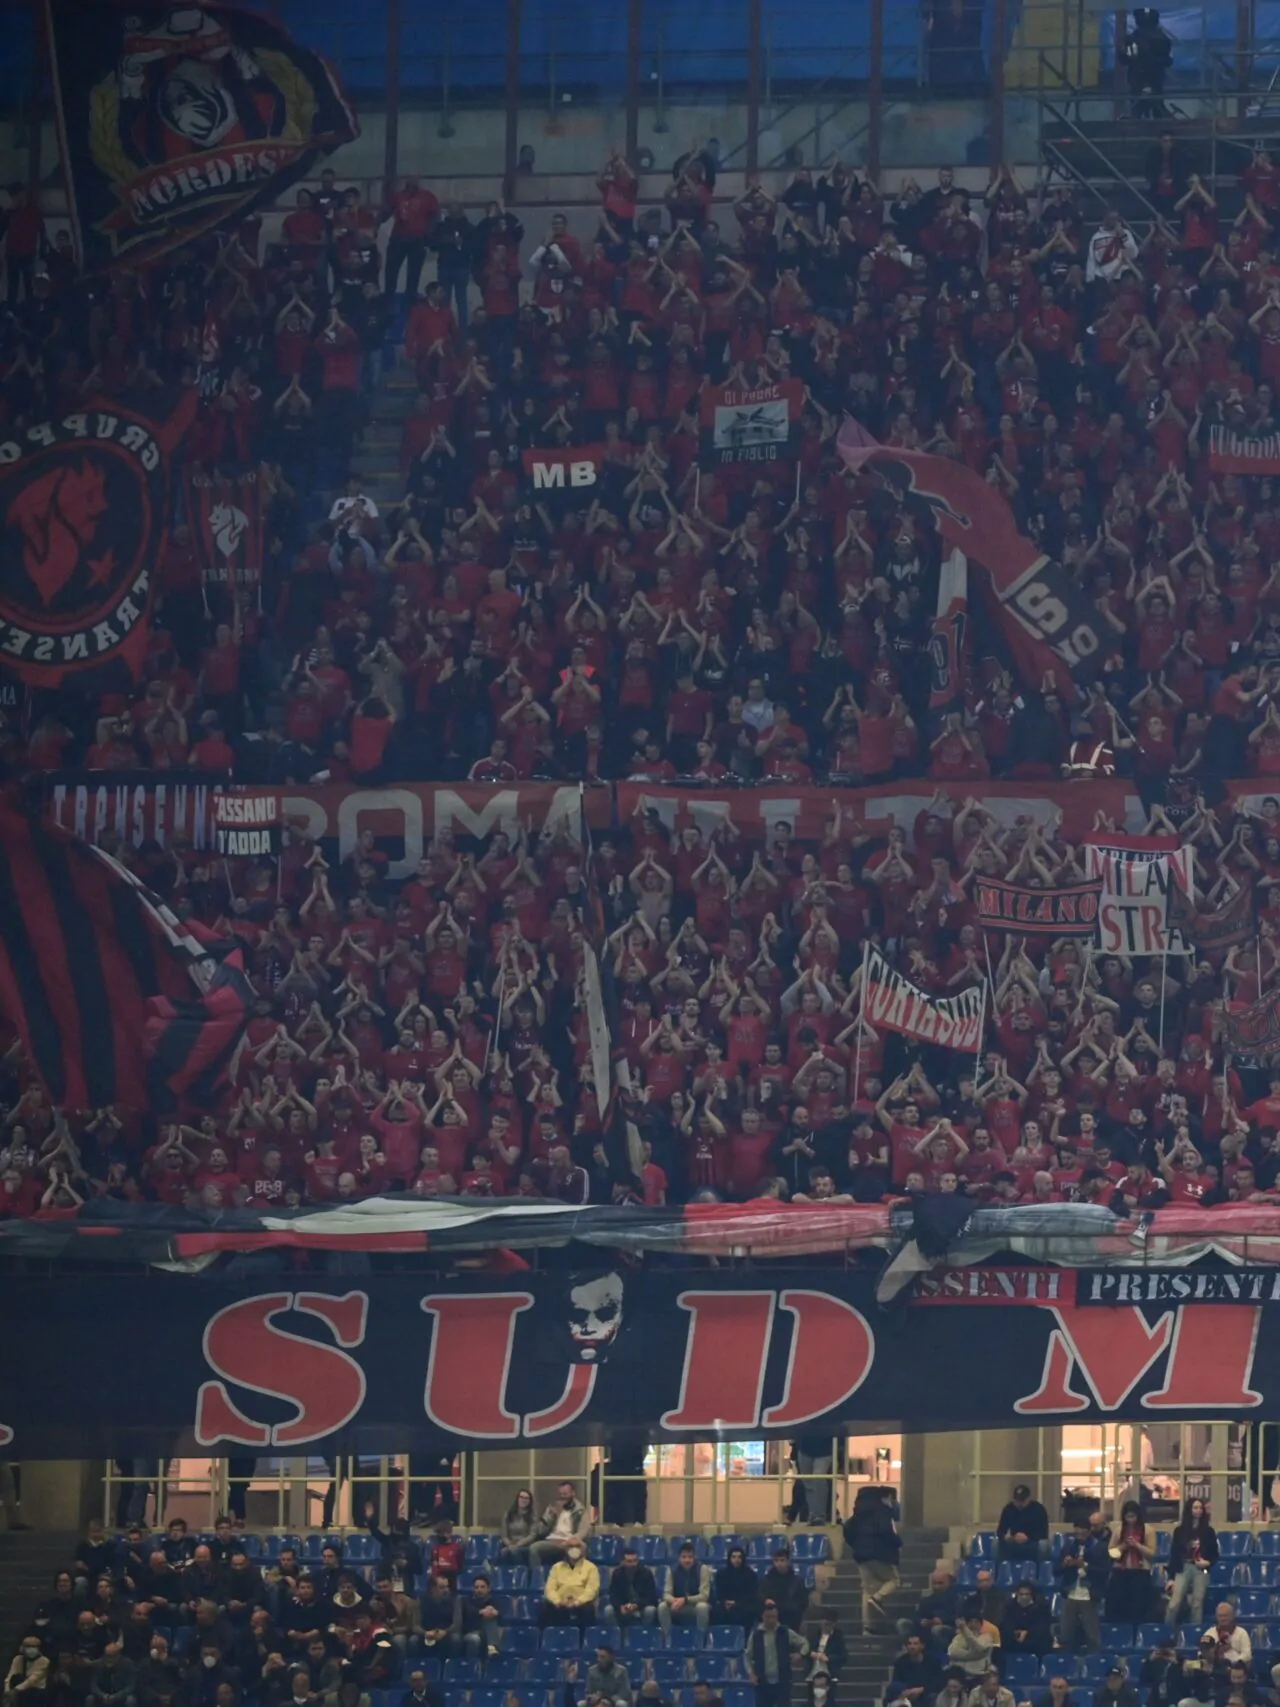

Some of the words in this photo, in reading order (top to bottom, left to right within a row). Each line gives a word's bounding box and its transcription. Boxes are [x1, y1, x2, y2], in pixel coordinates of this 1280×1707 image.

[531, 461, 597, 489] MB
[1091, 847, 1189, 897] MILAN
[979, 885, 1098, 922] MILANO
[194, 1289, 876, 1446] SUD
